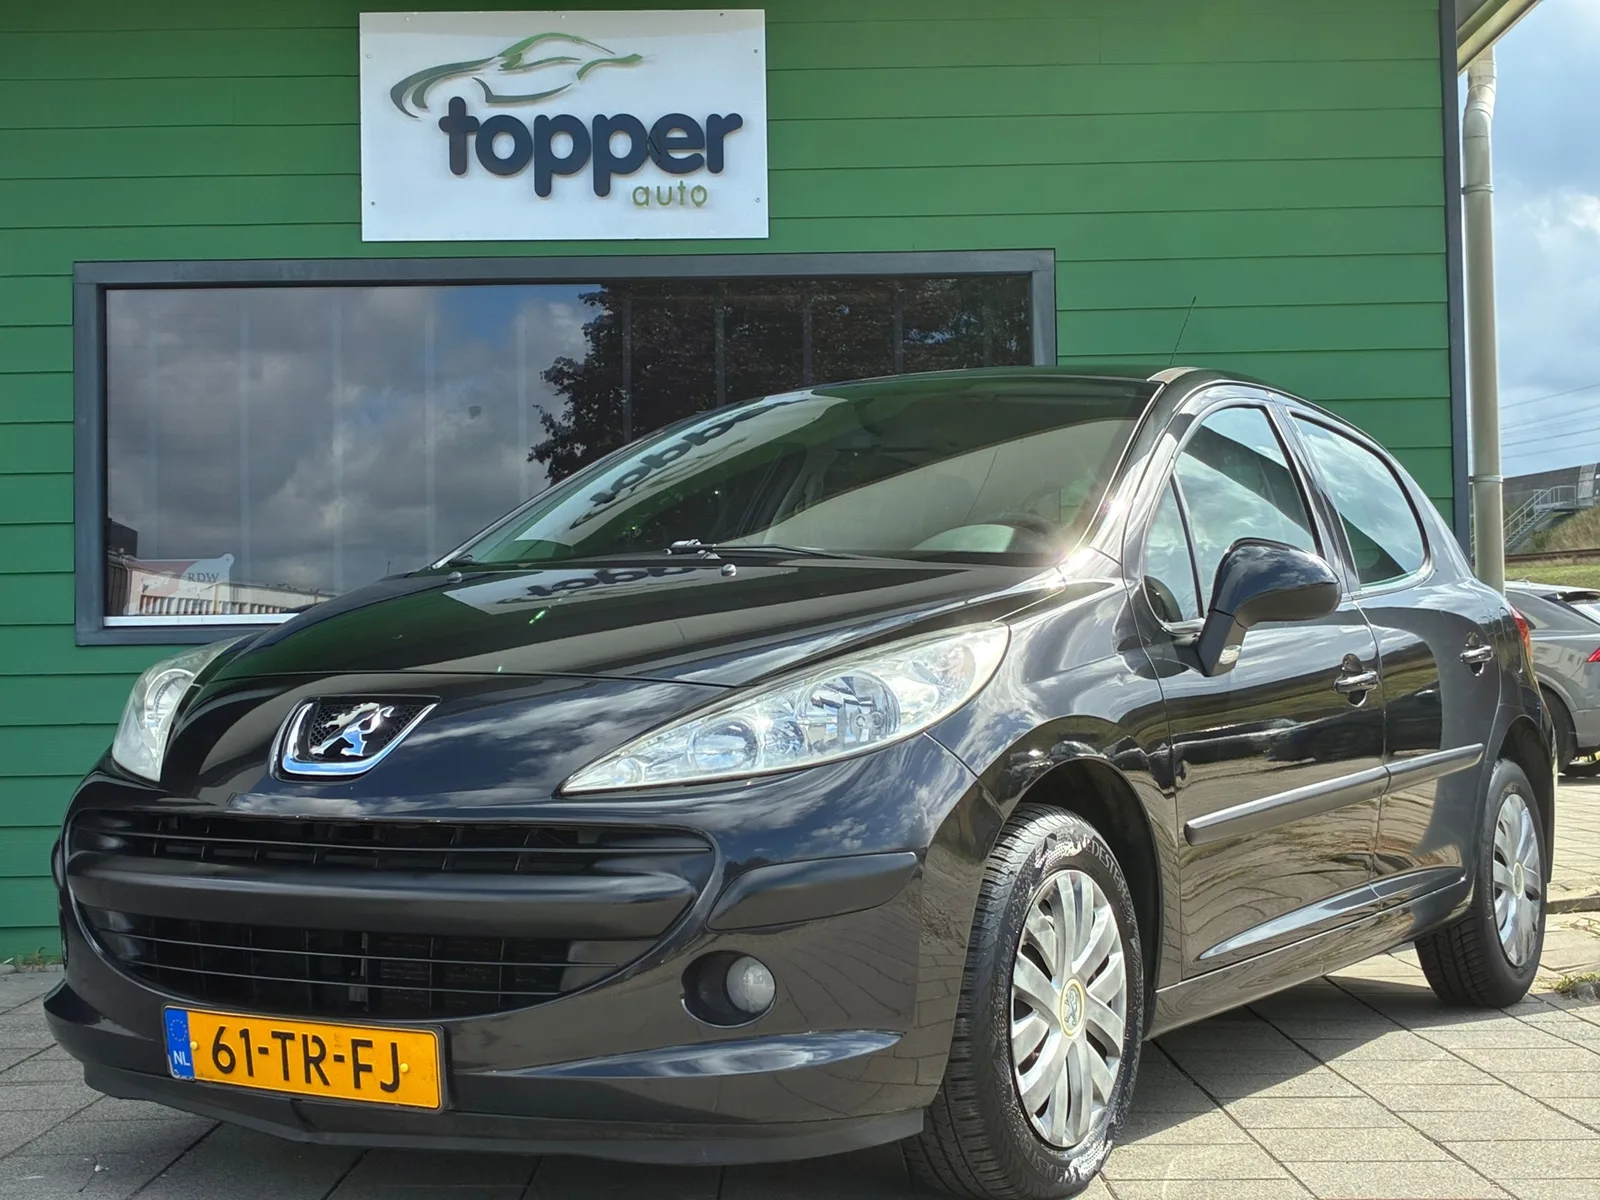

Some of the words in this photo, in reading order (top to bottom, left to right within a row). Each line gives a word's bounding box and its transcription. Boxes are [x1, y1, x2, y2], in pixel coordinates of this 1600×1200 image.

[438, 96, 743, 198] topper
[632, 180, 708, 208] auto
[187, 572, 219, 582] RDW
[173, 1050, 191, 1066] NL
[212, 1025, 401, 1094] 61-TR-FJ
